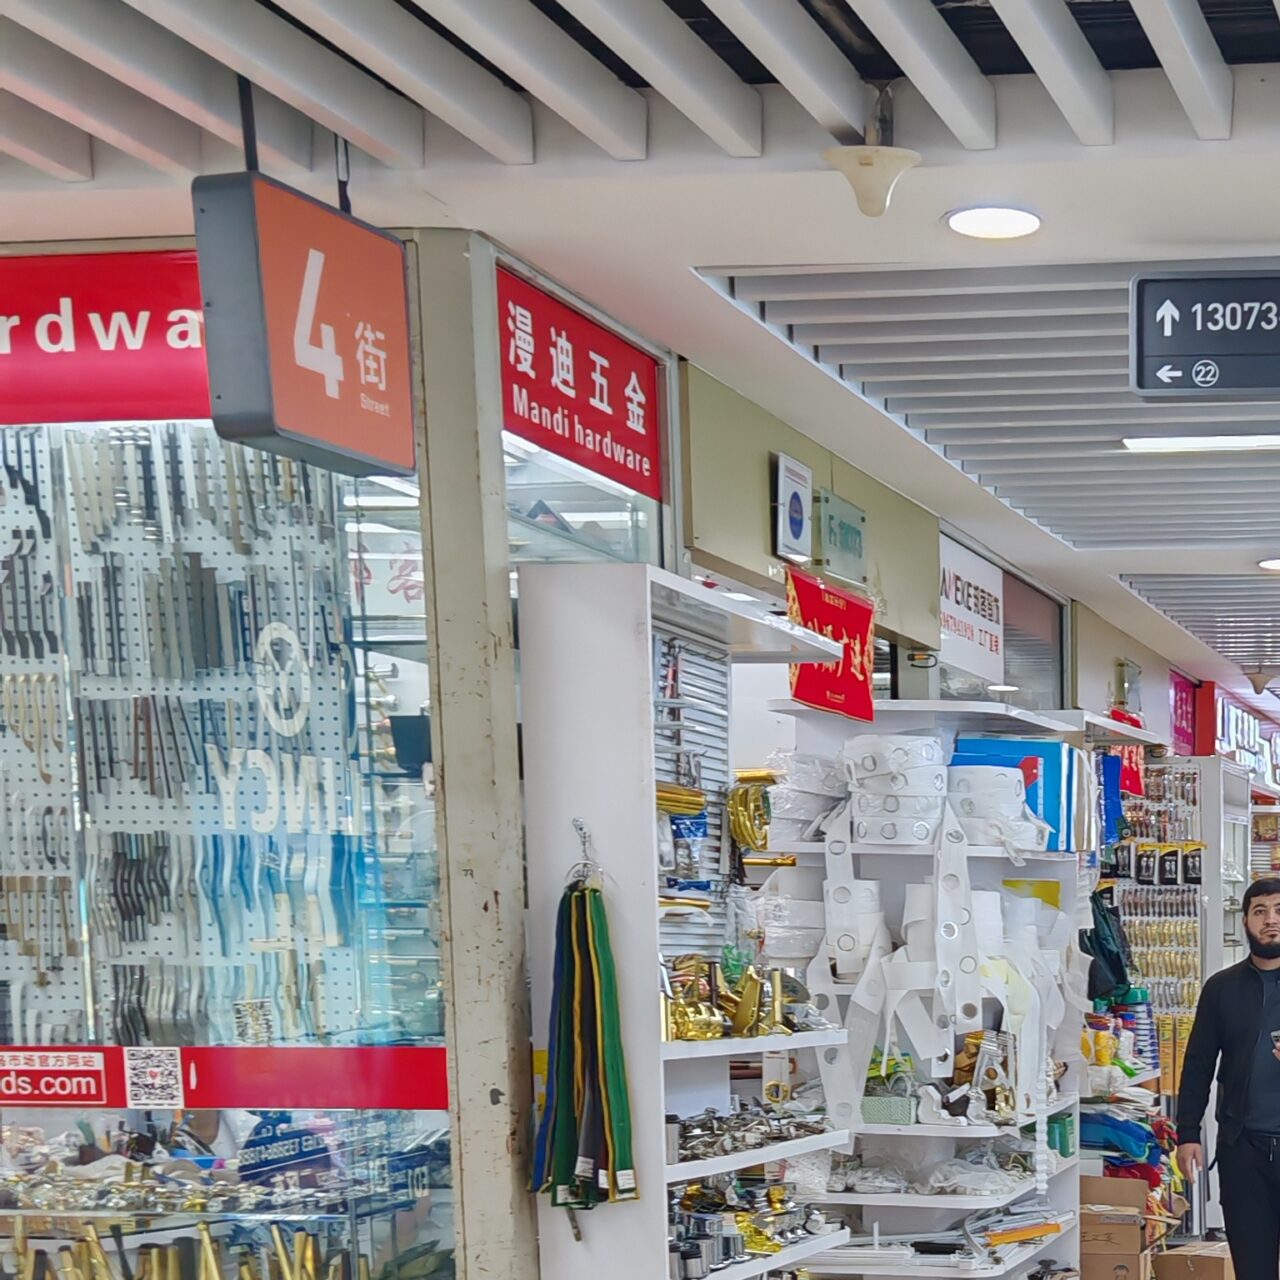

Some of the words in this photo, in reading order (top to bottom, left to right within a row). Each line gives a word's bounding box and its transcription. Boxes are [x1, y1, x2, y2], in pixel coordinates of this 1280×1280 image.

[294, 248, 344, 400] 4
[355, 321, 387, 391] 街
[507, 300, 646, 435] 漫迪五金
[1195, 364, 1216, 383] 22
[512, 384, 570, 438] Mandi
[574, 414, 651, 476] hardware
[0, 1054, 96, 1068] 市场官方网站
[1, 1071, 97, 1095] ds.com
